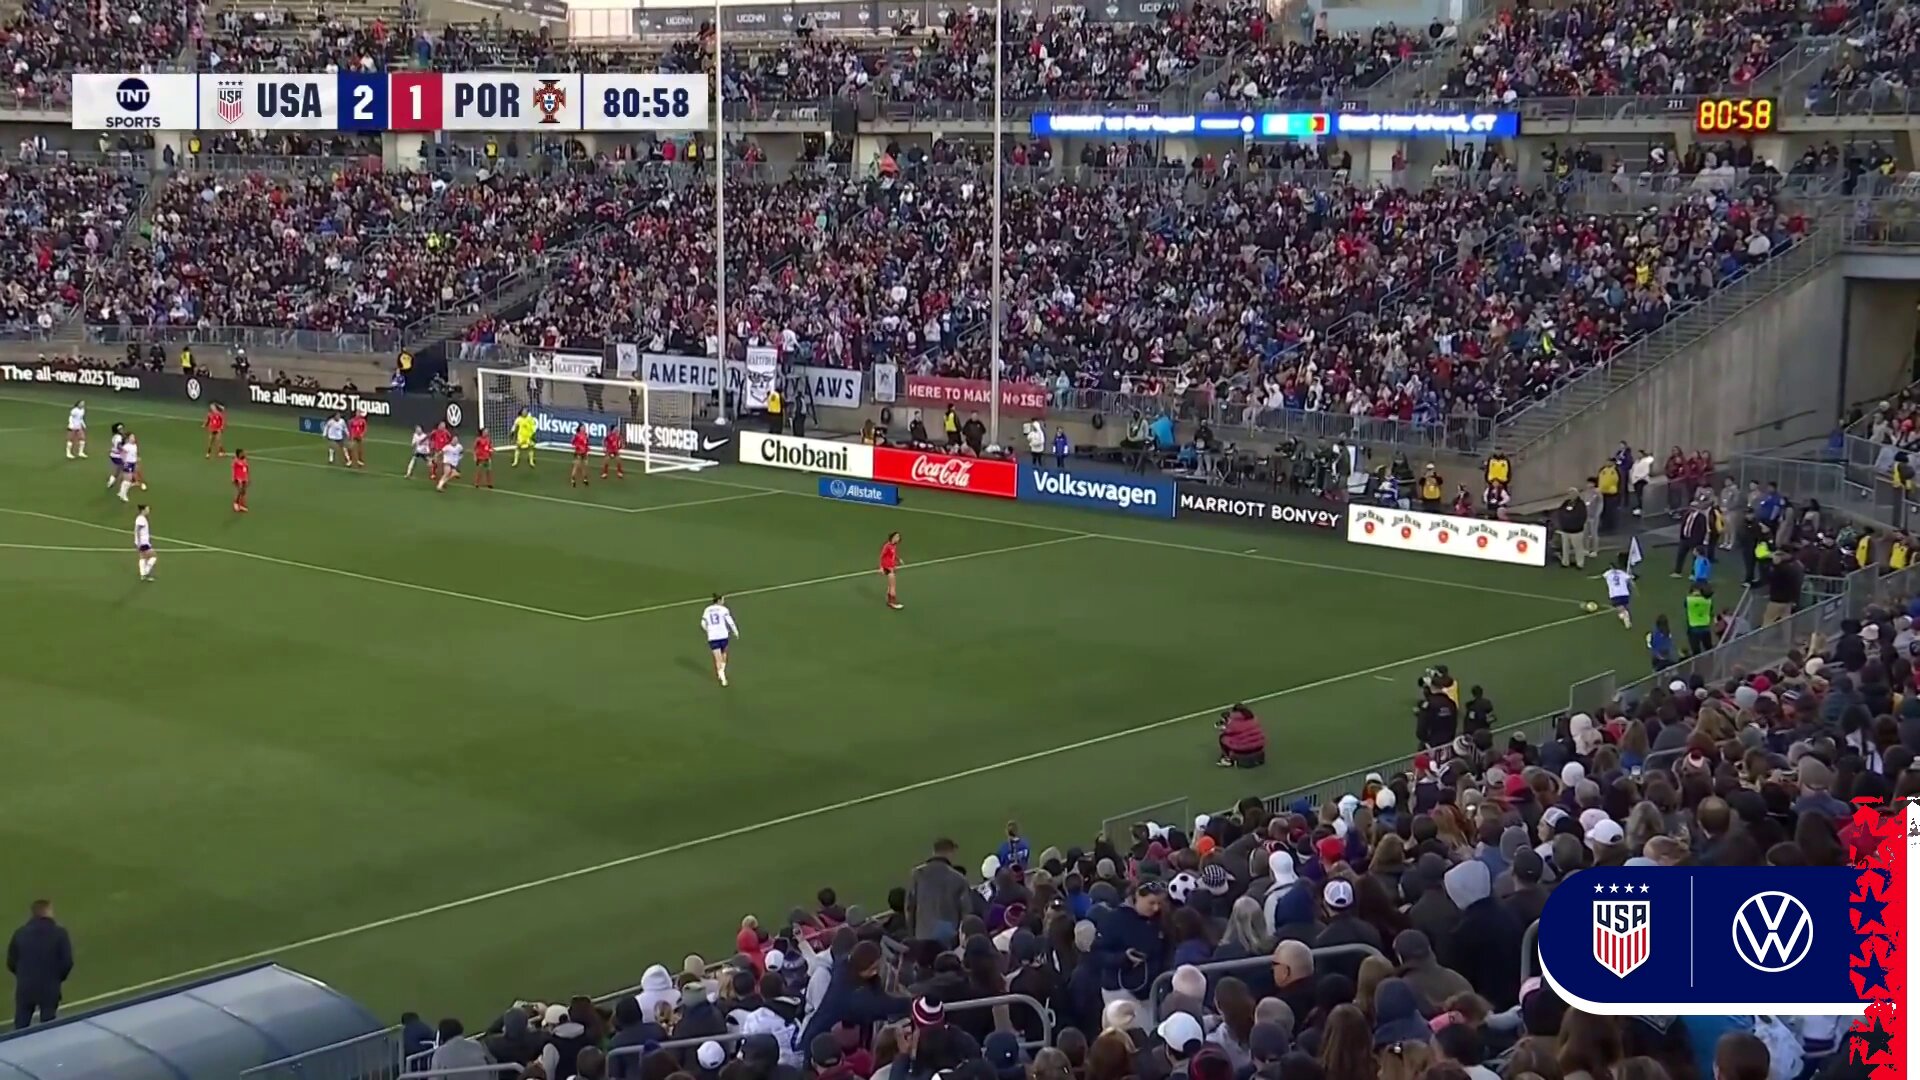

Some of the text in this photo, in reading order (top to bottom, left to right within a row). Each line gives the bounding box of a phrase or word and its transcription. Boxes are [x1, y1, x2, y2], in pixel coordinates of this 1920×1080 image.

[665, 16, 694, 25] UCONN
[1700, 99, 1772, 130] 80:58
[0, 364, 140, 391] The all-new 2025 Tiguan
[649, 362, 740, 389] AMERICN
[249, 384, 390, 417] The all-new 2025 Tiguan
[908, 384, 942, 399] HERE
[944, 387, 961, 401] TO
[963, 388, 991, 403] MAK
[654, 426, 699, 452] SOCCER
[761, 438, 848, 471] Chobani
[846, 484, 883, 500] Allstate
[1033, 469, 1157, 508] Volkswagen
[1180, 494, 1340, 528] MARRIOTT BONVOY
[1612, 575, 1621, 587] 9
[710, 613, 720, 625] 13
